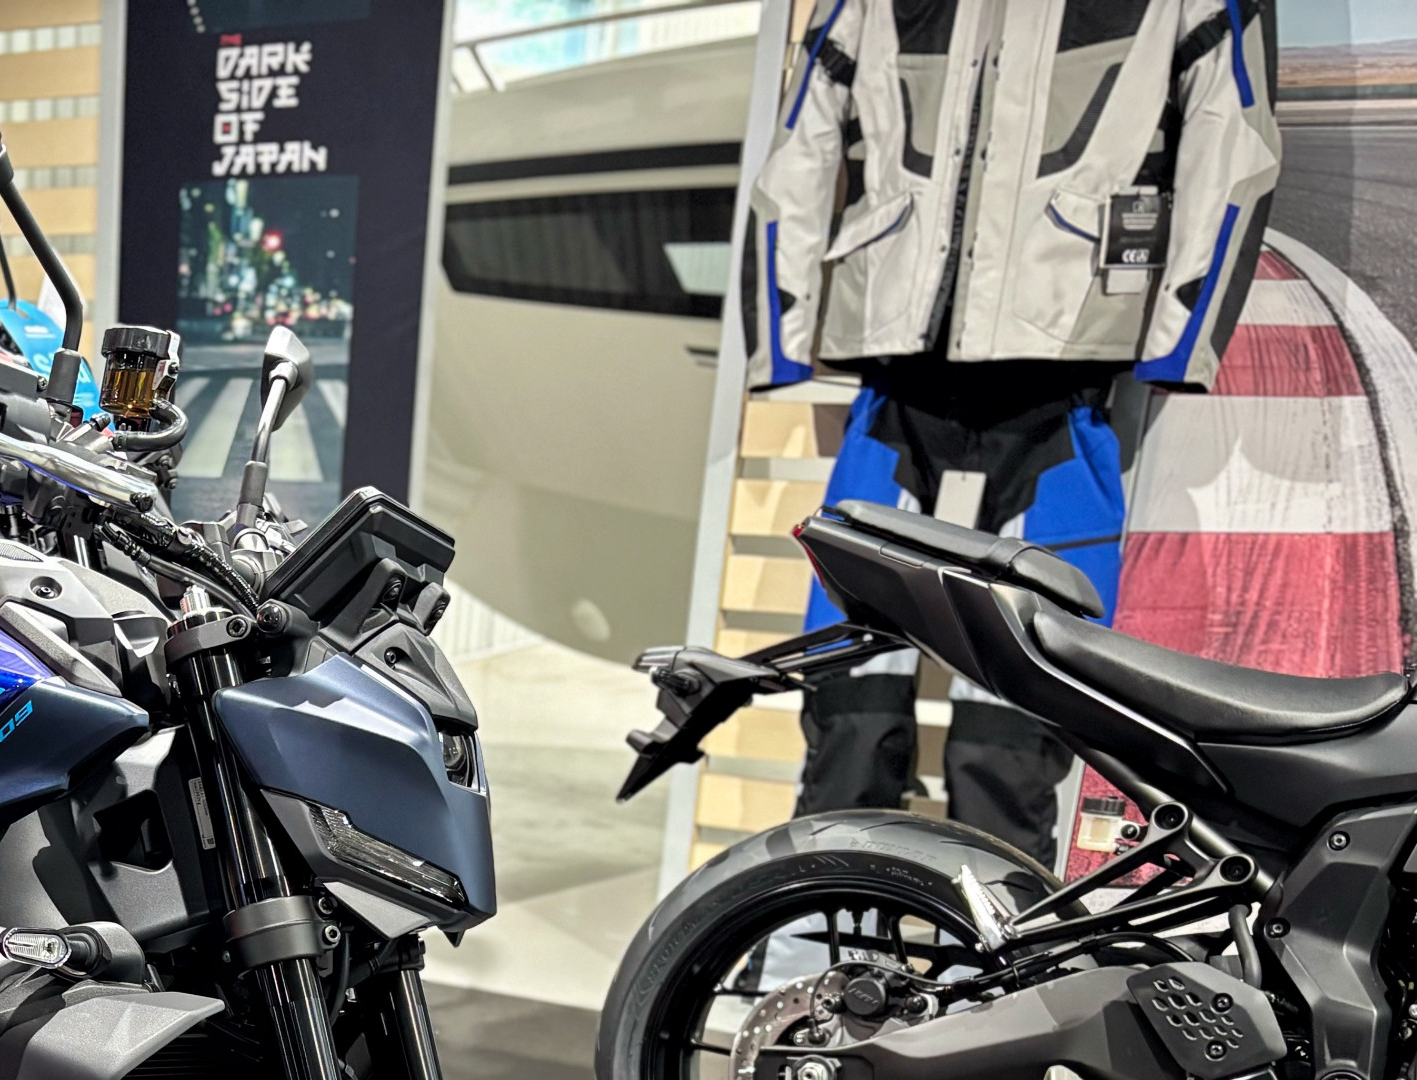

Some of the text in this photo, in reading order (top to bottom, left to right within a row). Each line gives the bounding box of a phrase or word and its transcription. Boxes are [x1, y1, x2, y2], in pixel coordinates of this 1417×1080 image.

[215, 41, 313, 79] DARK
[213, 111, 265, 145] OF
[211, 140, 328, 177] JAPAN
